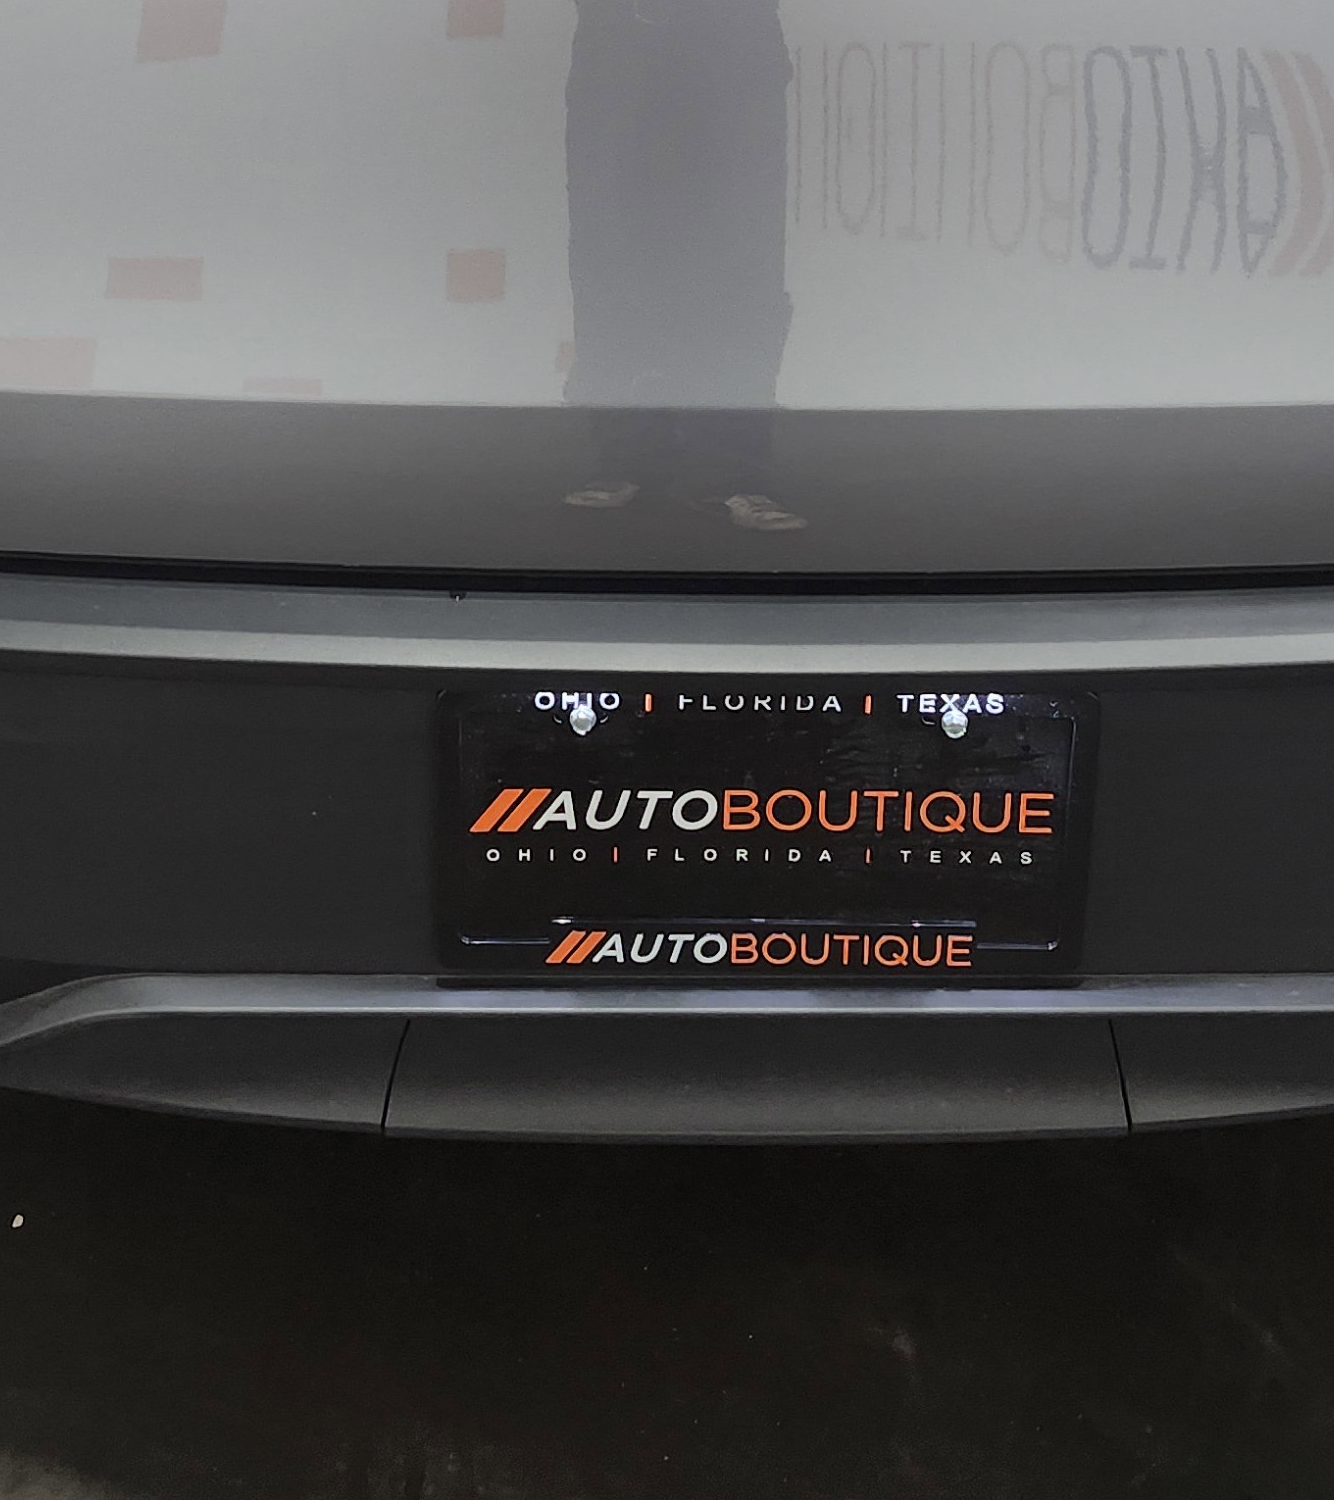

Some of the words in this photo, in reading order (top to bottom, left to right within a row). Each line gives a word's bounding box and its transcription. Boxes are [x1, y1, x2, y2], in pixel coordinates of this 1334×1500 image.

[534, 690, 620, 711] OHIO
[678, 693, 843, 712] FLORIDA
[896, 692, 1005, 715] TEXAS
[532, 789, 1055, 834] AUTOBOUTIQUE
[485, 848, 587, 862] OHIO
[646, 848, 832, 863] FLORIDA
[899, 850, 1034, 865] TEXAS
[592, 932, 974, 967] AUTOBOUTIQUE
